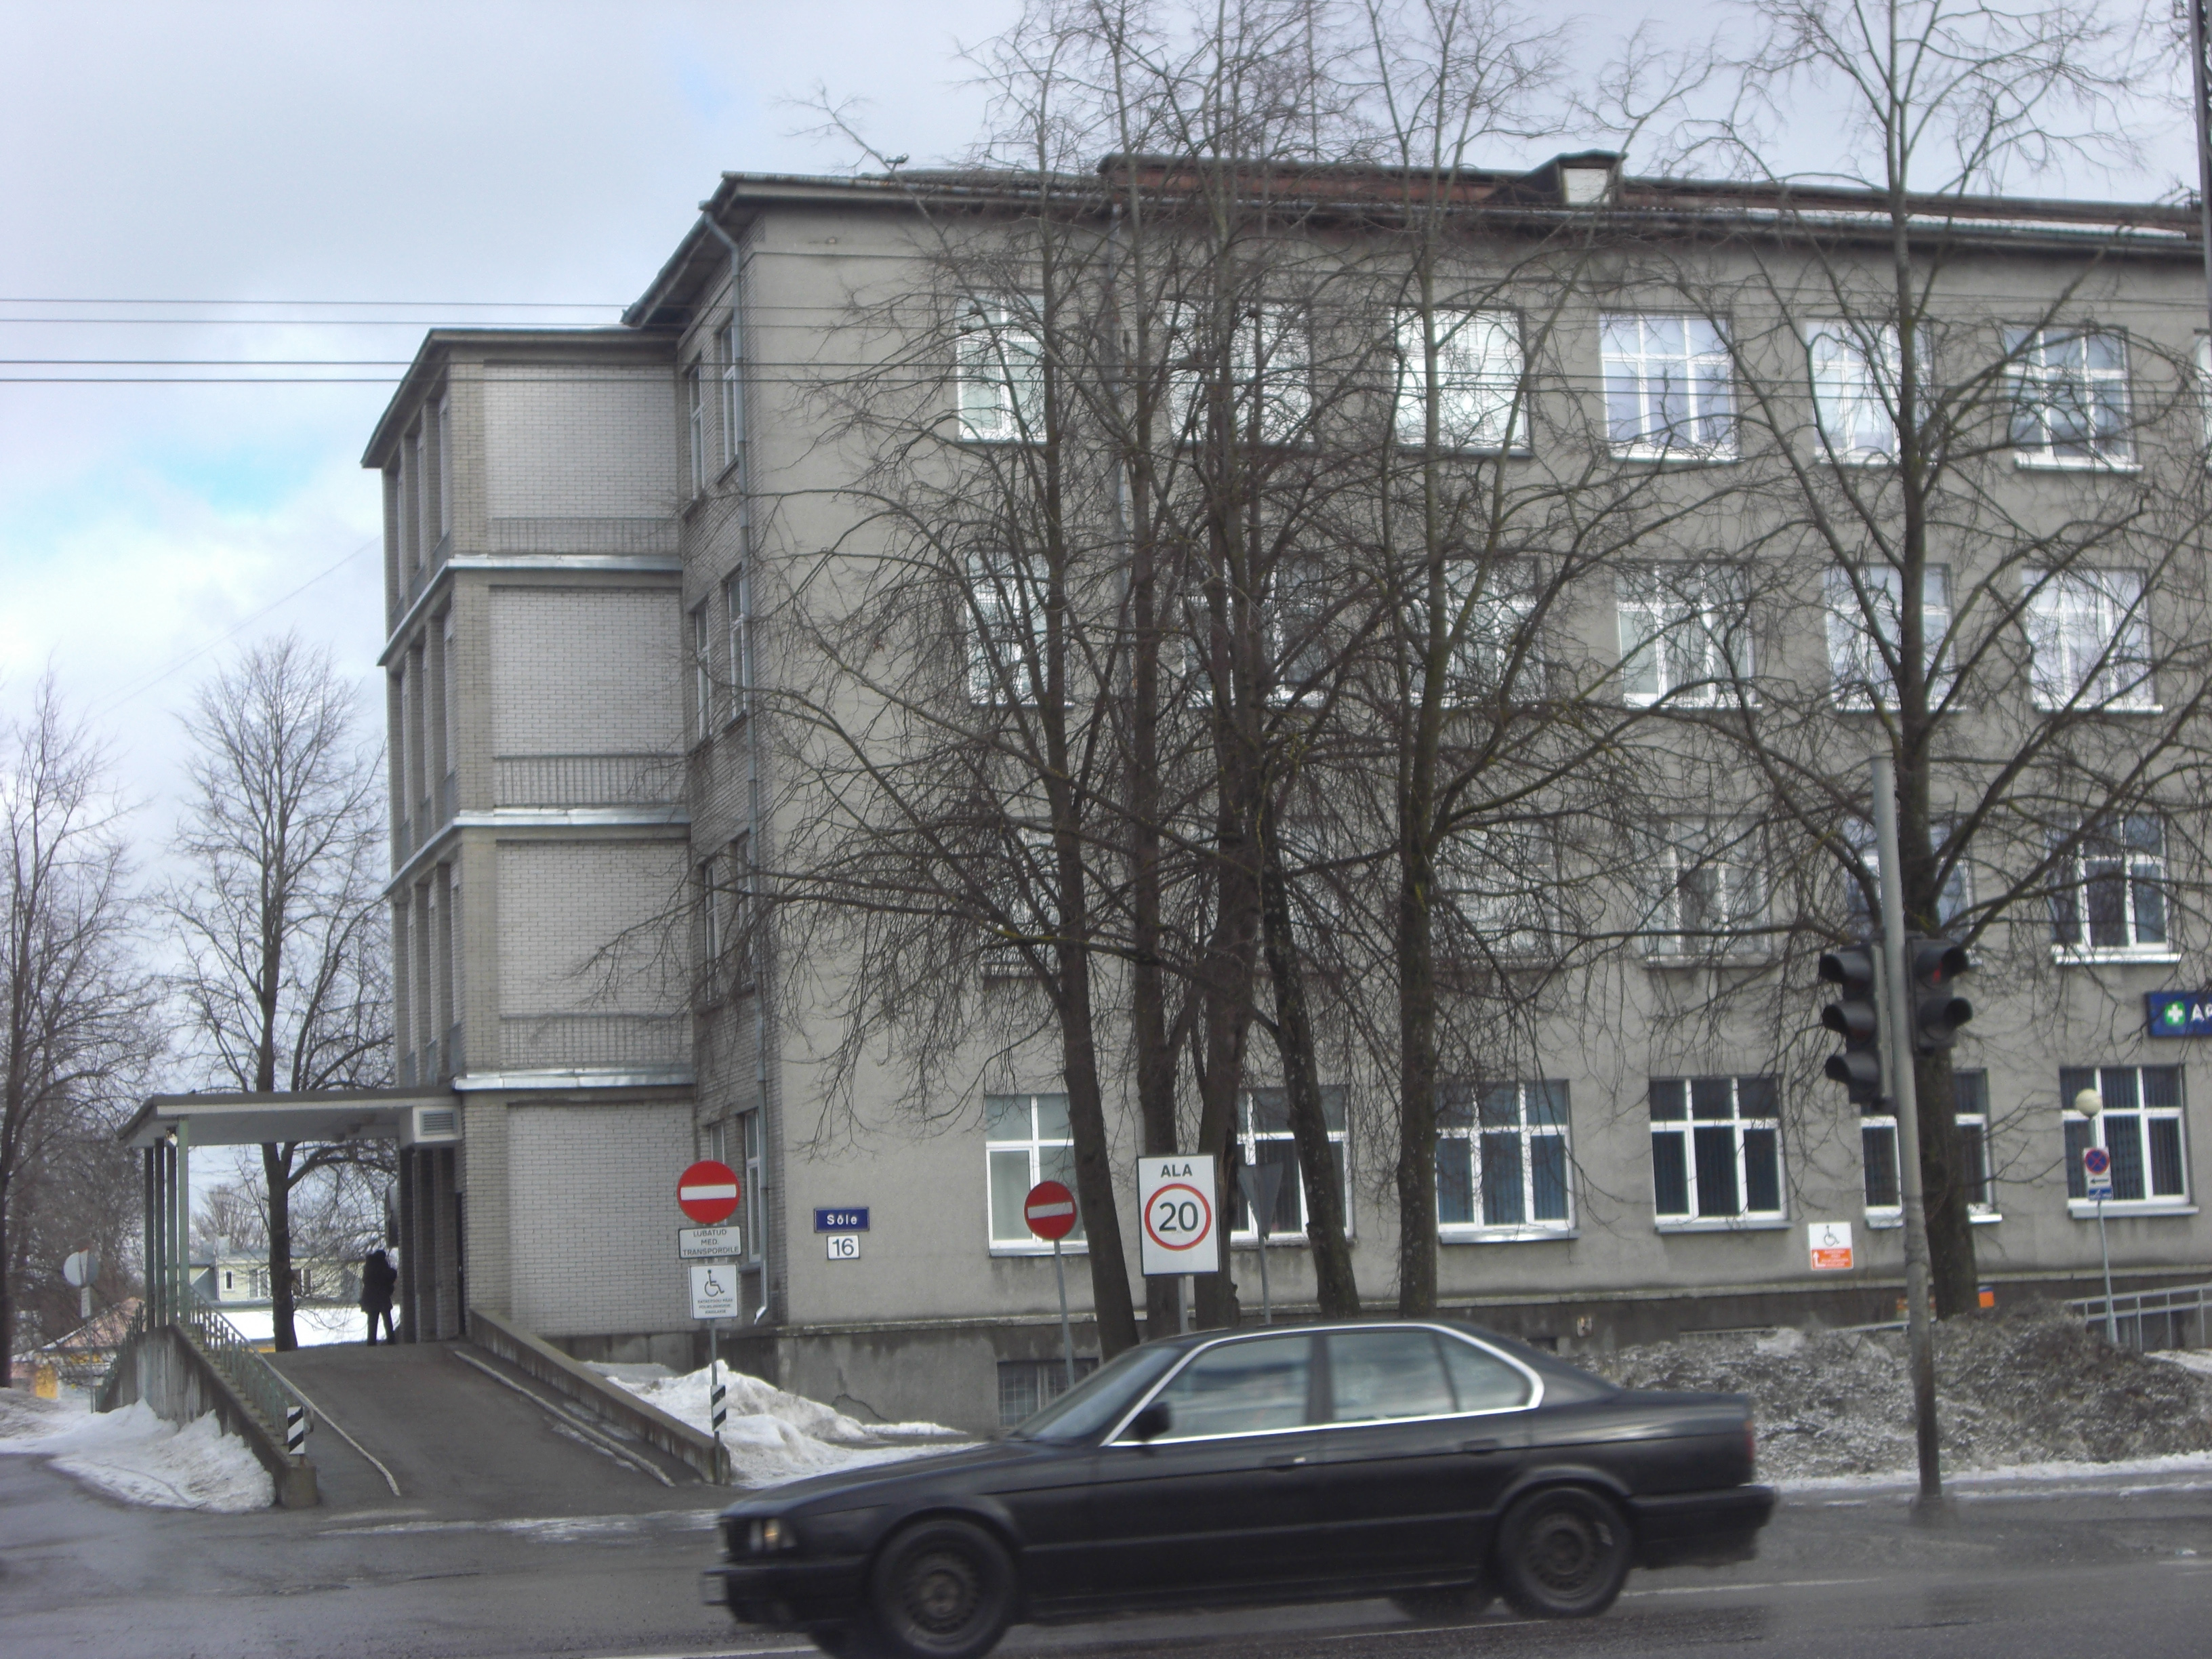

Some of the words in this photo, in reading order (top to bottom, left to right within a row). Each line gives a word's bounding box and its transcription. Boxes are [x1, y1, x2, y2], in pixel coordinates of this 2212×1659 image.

[1160, 1164, 1193, 1178] ALA
[1159, 1202, 1199, 1232] 20
[693, 1229, 726, 1237] LUBATUD
[682, 1246, 738, 1256] TRANSPORDILE
[832, 1238, 854, 1256] 16
